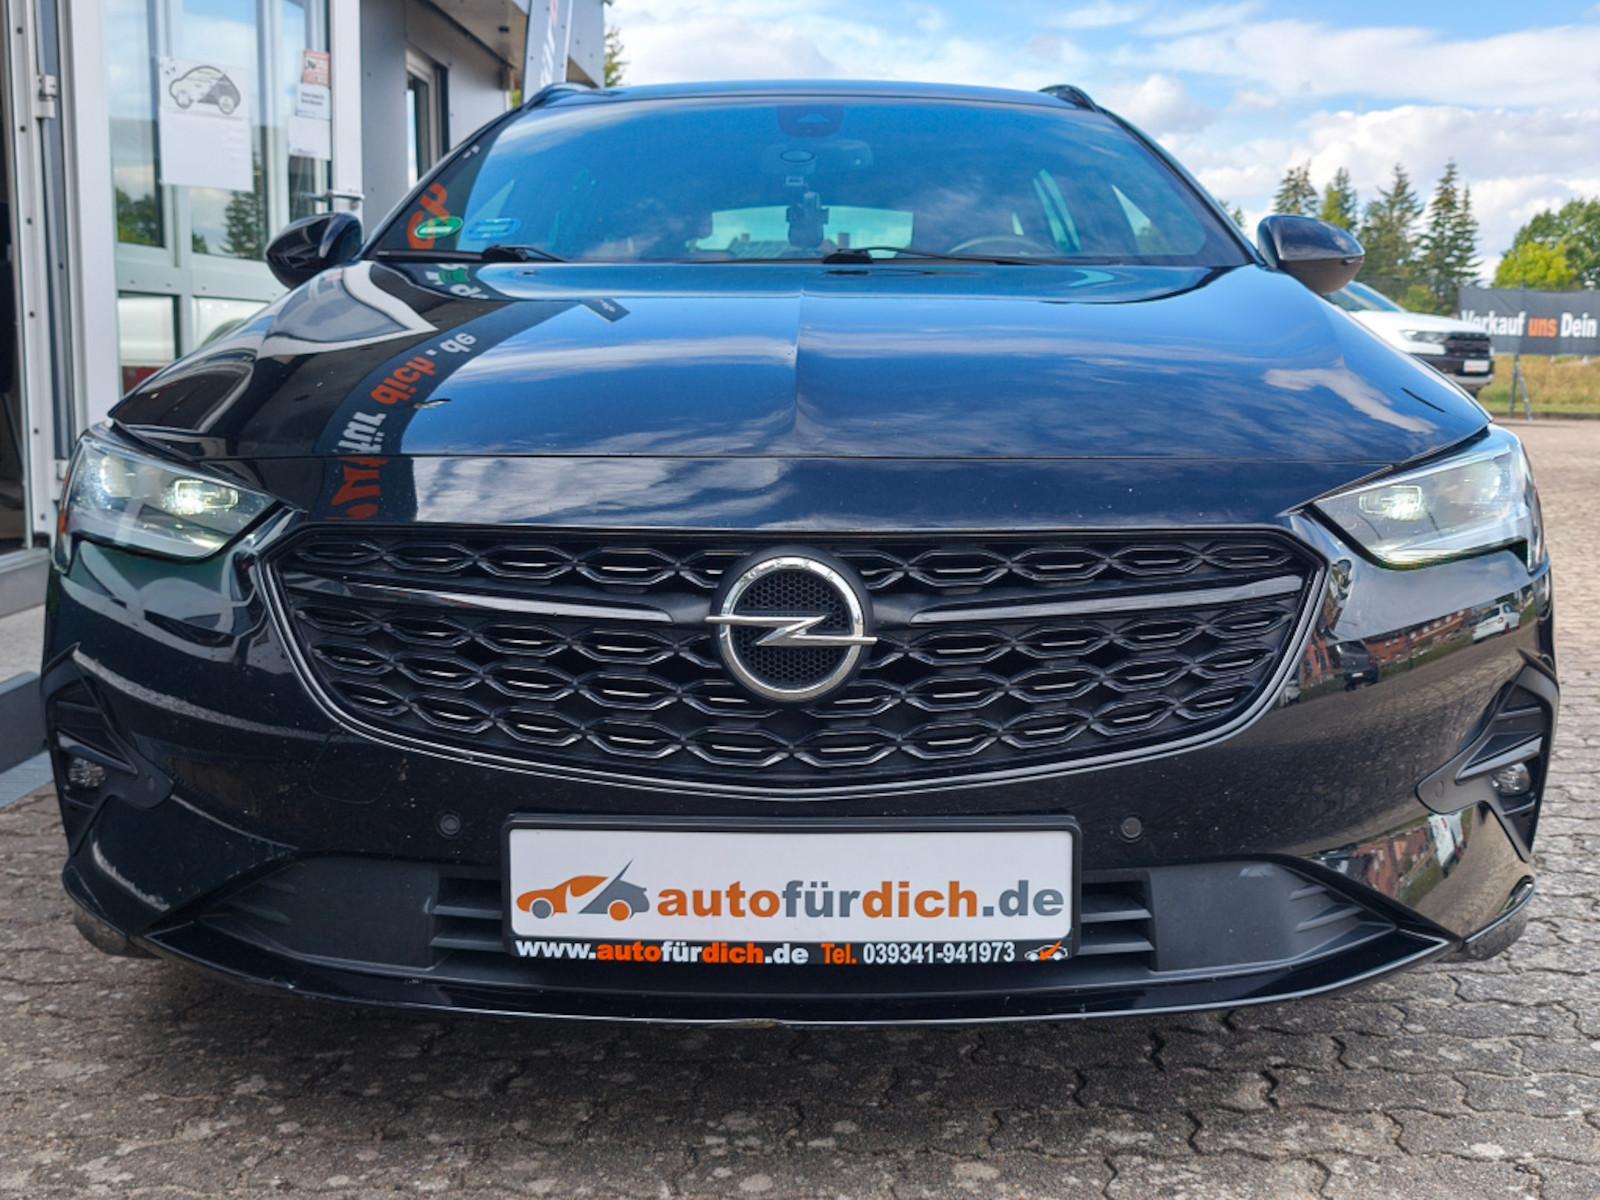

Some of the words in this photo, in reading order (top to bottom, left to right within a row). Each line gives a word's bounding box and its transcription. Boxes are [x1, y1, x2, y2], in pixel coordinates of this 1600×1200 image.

[1528, 316, 1557, 337] uns
[1560, 311, 1597, 338] Dein
[656, 879, 1065, 919] autofürdich.de
[515, 939, 809, 964] www.autofürdich.de
[820, 943, 857, 965] Tel.
[862, 941, 1016, 964] 039341-941973
